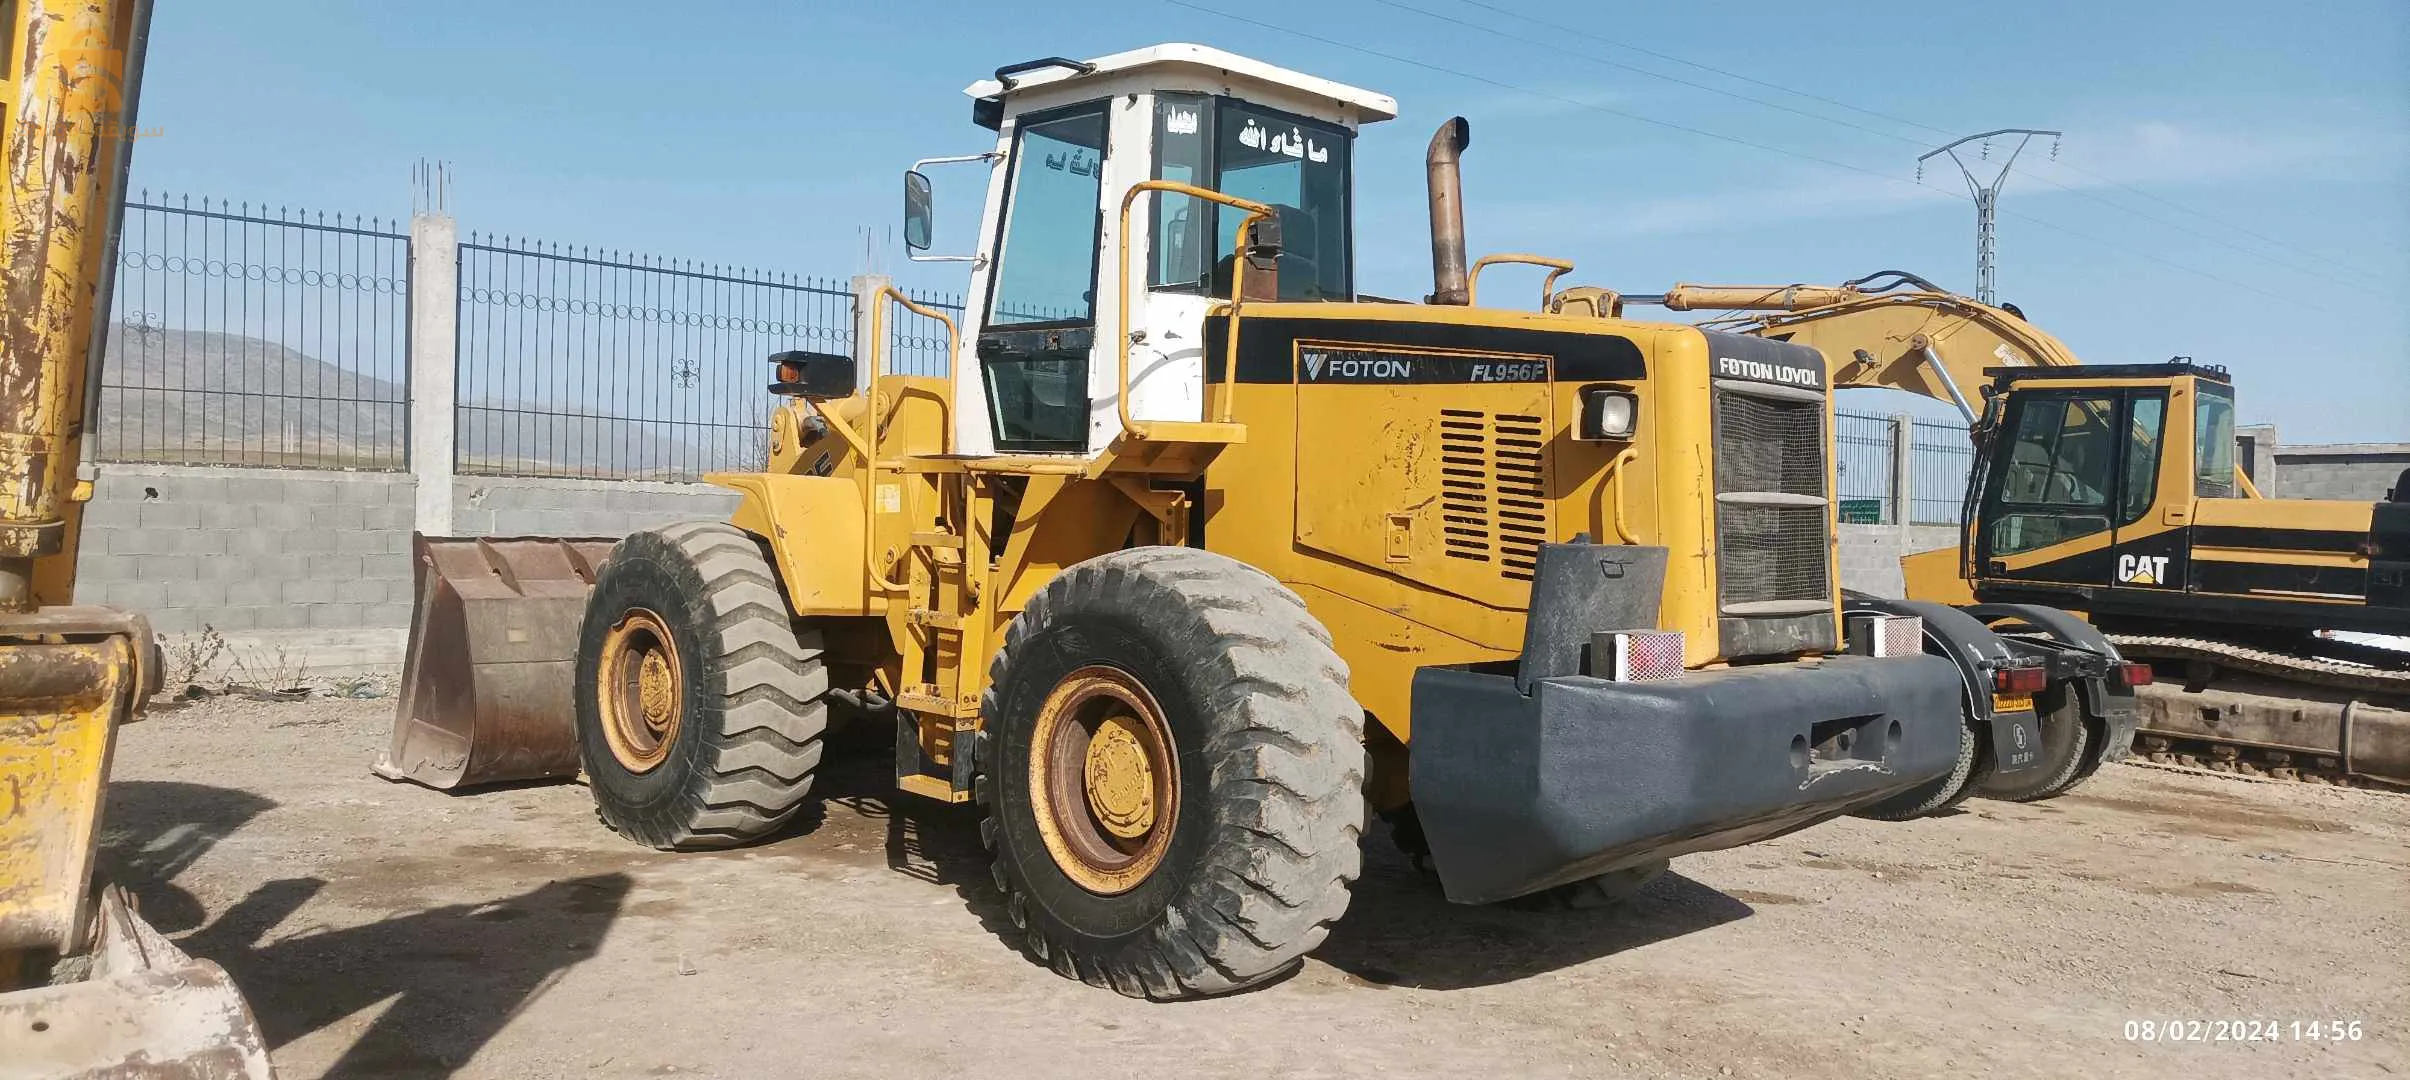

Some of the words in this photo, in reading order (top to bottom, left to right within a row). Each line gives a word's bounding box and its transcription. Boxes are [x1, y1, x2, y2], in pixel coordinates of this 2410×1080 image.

[1238, 119, 1267, 151] الله
[1308, 138, 1328, 163] ما
[1329, 360, 1411, 378] FOTON
[1470, 363, 1545, 382] FL956F
[1719, 357, 1774, 380] FOTON
[1775, 364, 1819, 386] LOVOL
[2118, 554, 2169, 585] CAT
